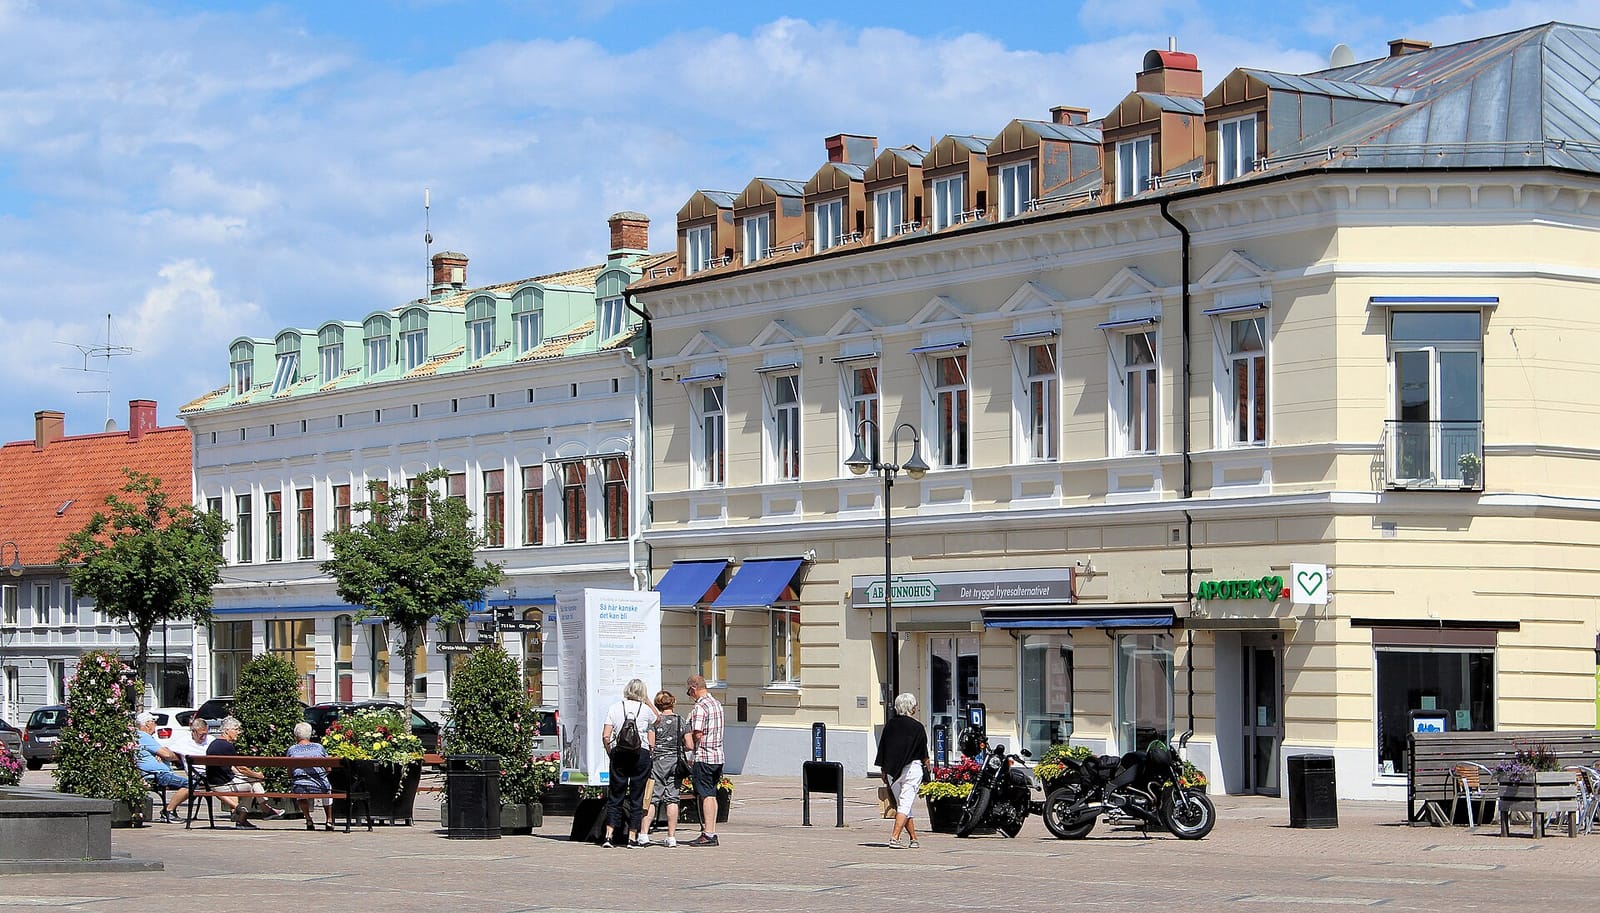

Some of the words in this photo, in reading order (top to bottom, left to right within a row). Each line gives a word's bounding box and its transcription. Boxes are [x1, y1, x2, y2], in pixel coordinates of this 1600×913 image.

[872, 587, 884, 598] AB
[890, 586, 931, 598] UNNOHUS
[961, 587, 972, 598] Det
[973, 587, 995, 600] trygga
[996, 584, 1050, 599] hyresalternativet
[1197, 579, 1262, 600] APOTEK
[618, 604, 638, 612] kanske
[609, 612, 620, 620] kan
